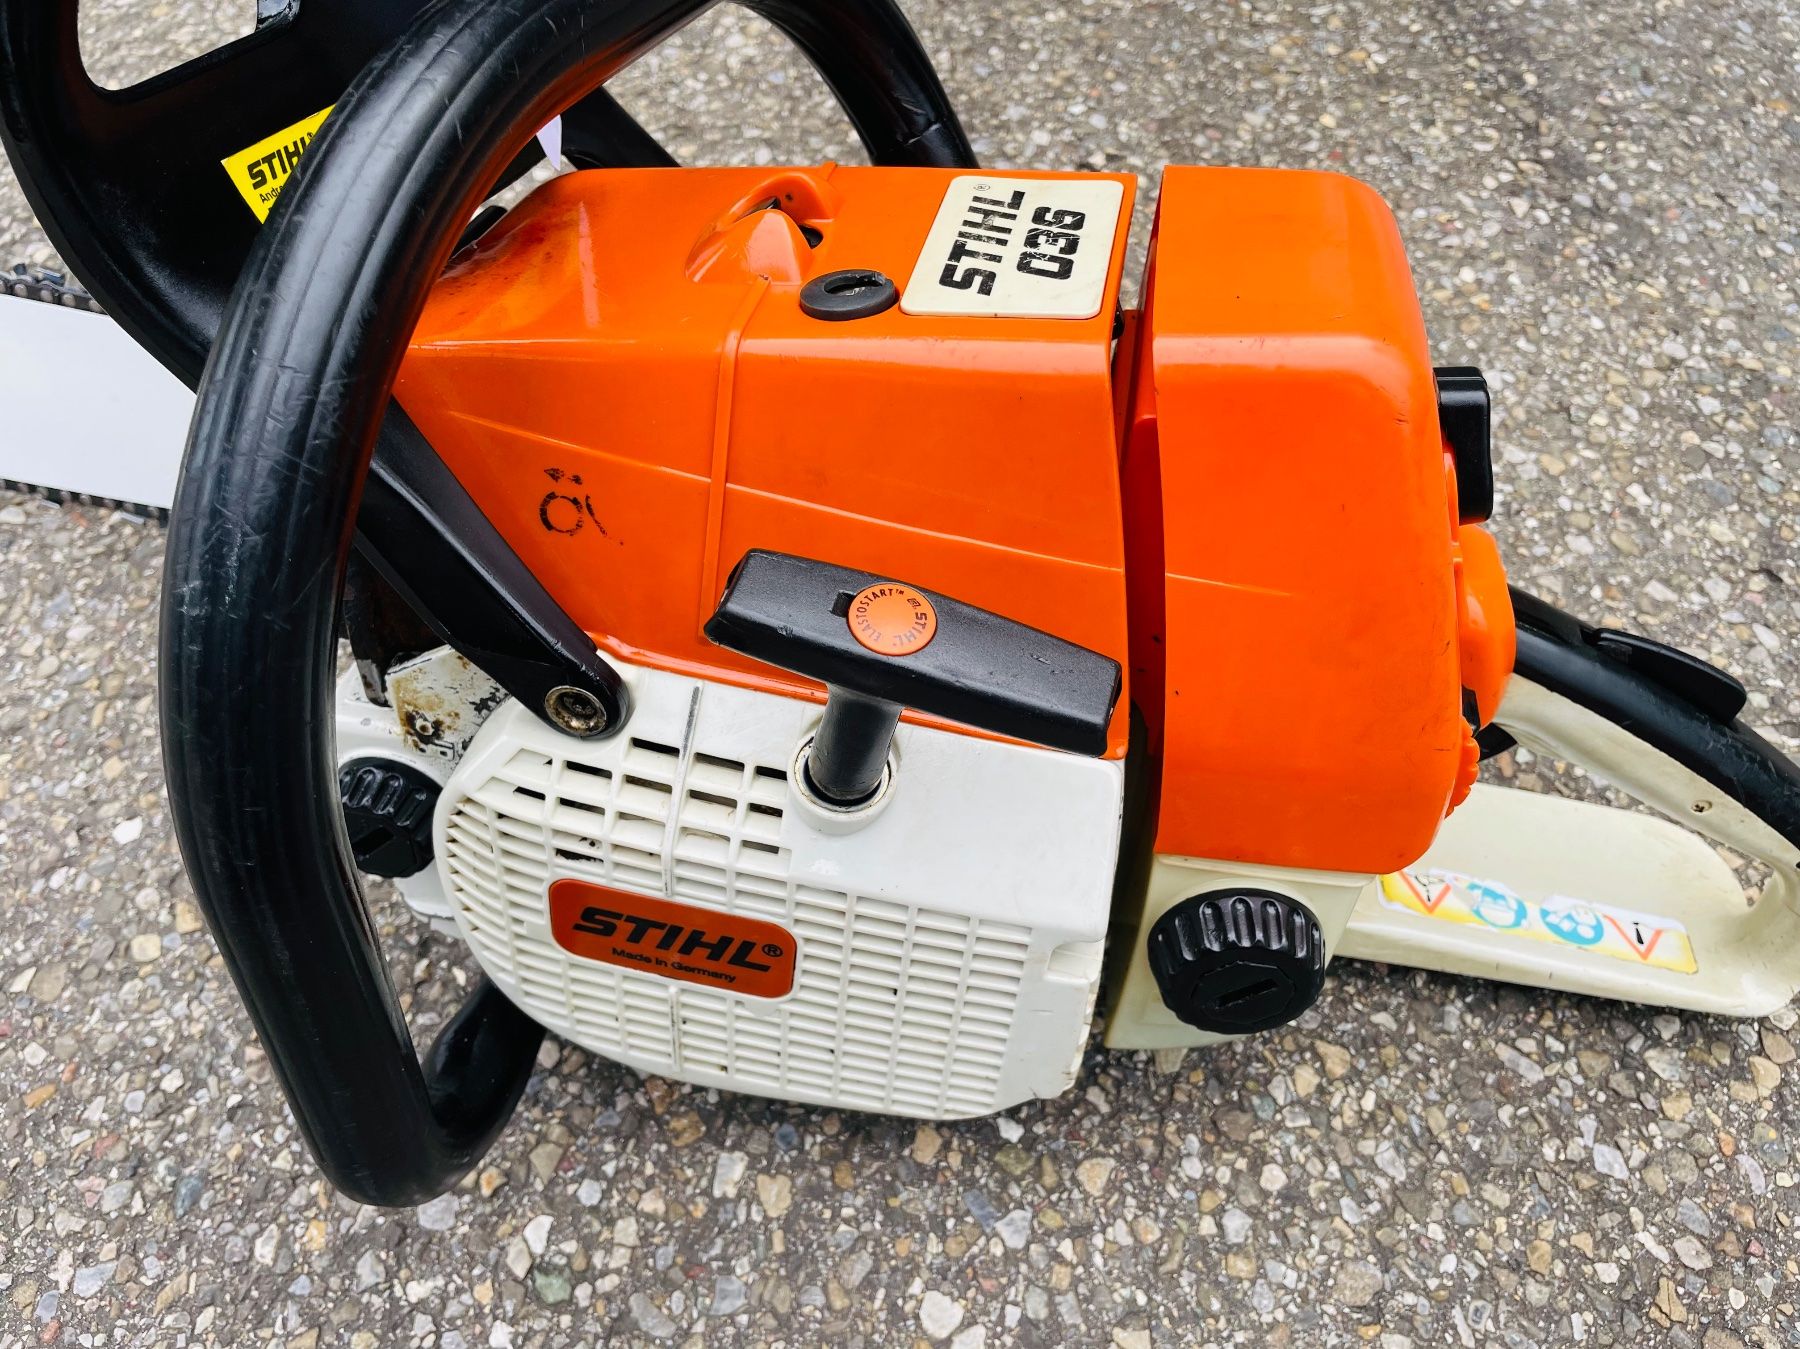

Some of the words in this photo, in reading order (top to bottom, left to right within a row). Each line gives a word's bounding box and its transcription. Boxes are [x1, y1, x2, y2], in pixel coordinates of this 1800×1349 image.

[1016, 206, 1086, 280] 036
[612, 947, 652, 963] Made
[671, 961, 737, 983] Germany
